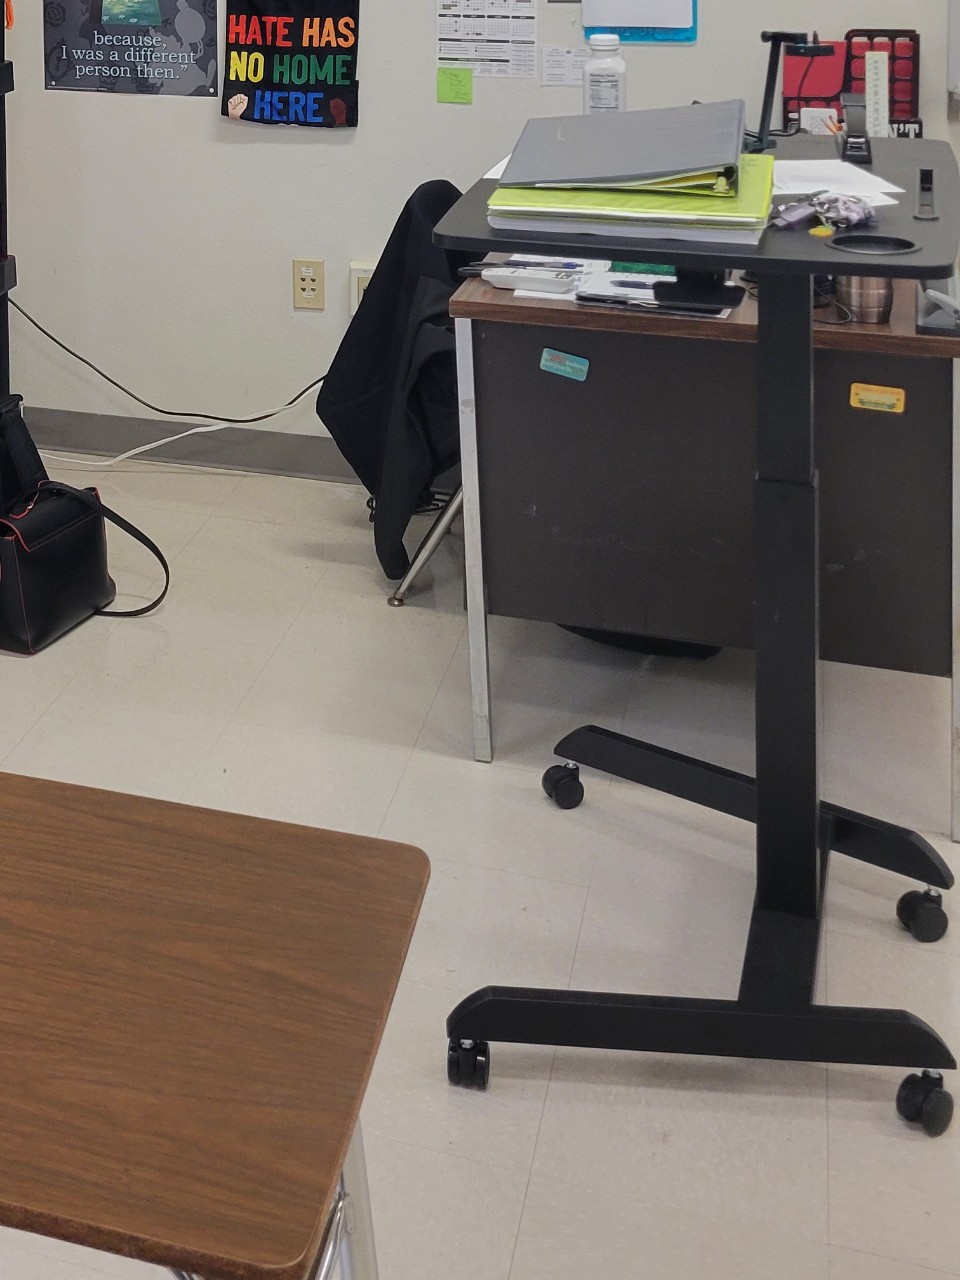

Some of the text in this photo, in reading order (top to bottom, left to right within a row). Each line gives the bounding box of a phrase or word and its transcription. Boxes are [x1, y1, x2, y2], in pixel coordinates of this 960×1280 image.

[94, 30, 167, 50] because,
[228, 14, 356, 48] HATE HAS
[61, 45, 196, 64] I was a different
[229, 51, 352, 85] NO HOME
[75, 64, 131, 78] person
[253, 89, 325, 123] HERE
